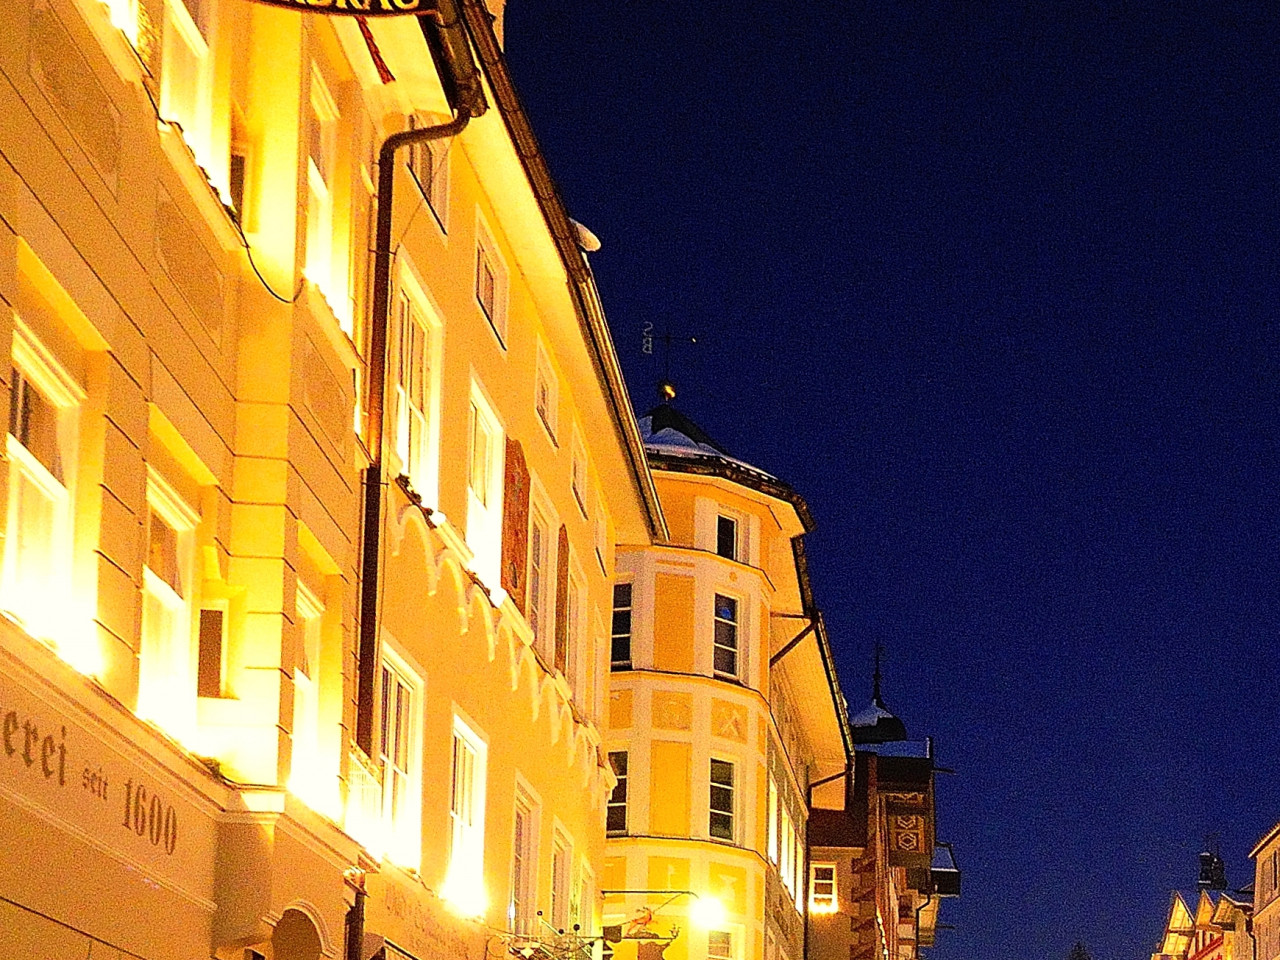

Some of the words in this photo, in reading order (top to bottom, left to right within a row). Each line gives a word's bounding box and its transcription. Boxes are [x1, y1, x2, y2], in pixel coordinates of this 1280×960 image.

[2, 710, 68, 786] erei
[82, 767, 109, 801] seit
[121, 777, 178, 856] 1600
